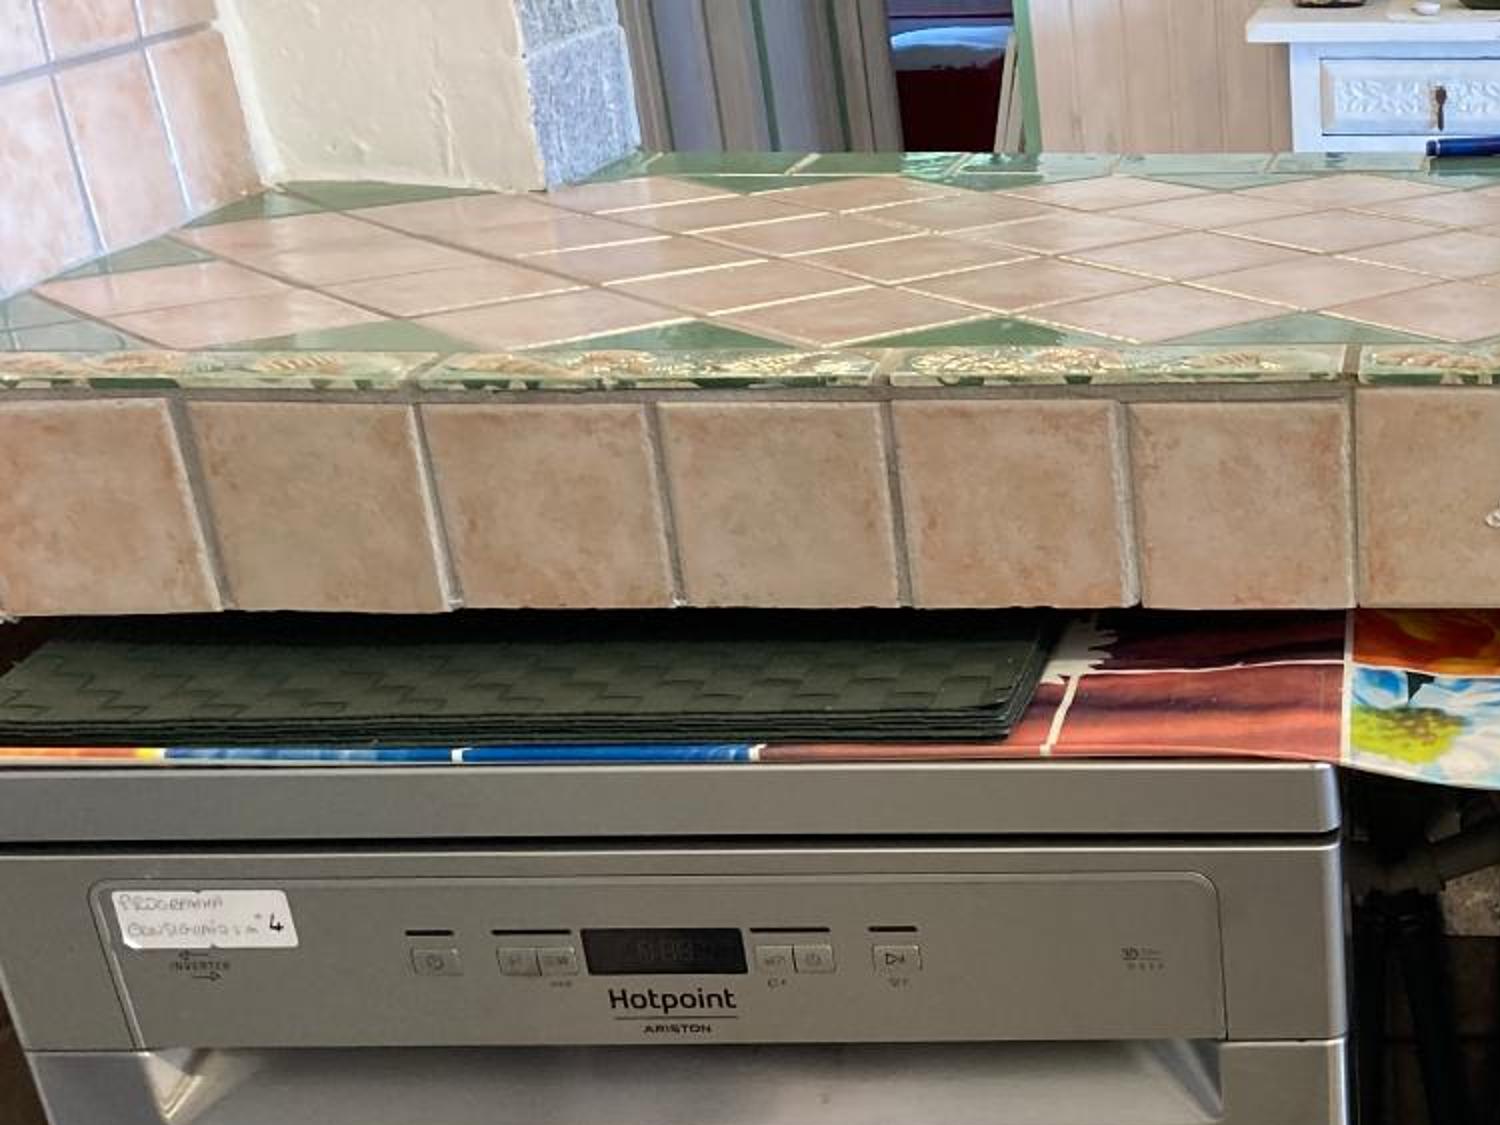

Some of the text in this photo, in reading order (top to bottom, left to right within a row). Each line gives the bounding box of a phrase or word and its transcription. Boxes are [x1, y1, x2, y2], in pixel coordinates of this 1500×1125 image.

[269, 912, 284, 932] 4
[608, 987, 738, 1014] Hotpoint
[643, 1023, 713, 1034] ARISTON
